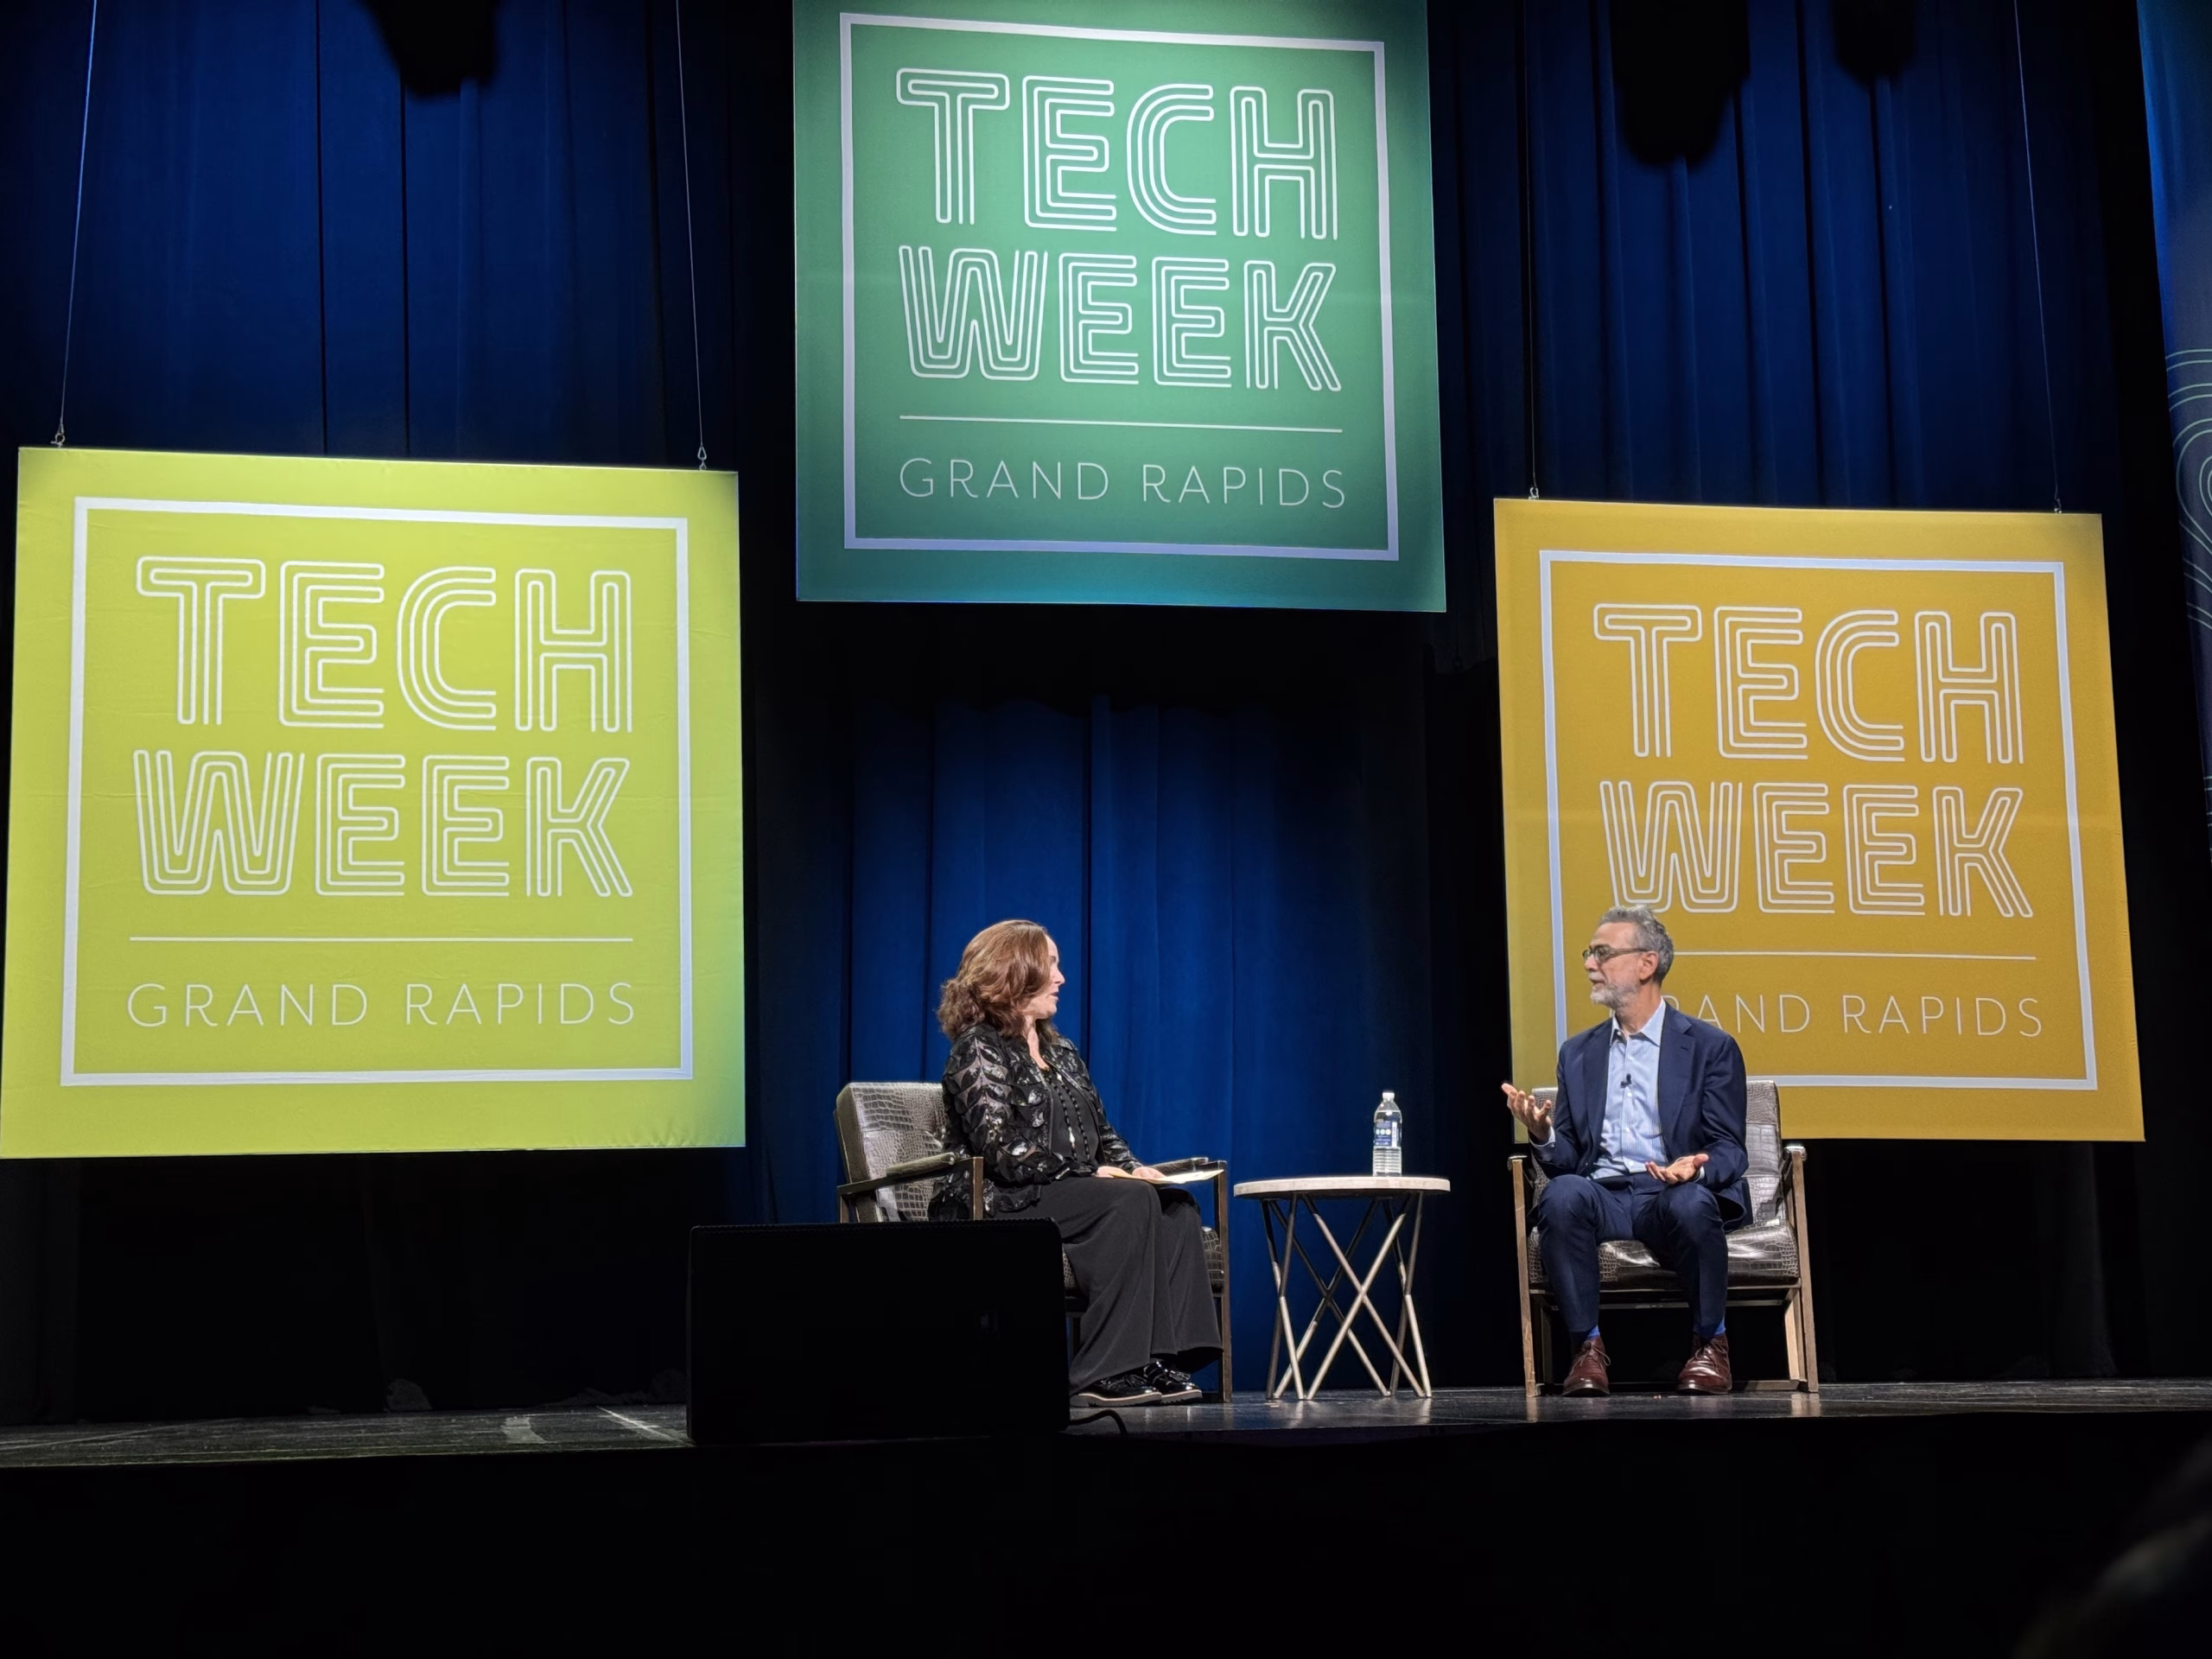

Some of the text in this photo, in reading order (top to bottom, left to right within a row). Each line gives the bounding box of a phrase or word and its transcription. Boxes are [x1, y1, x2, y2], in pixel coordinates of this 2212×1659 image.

[899, 69, 1338, 239] TECH
[899, 246, 1341, 391] WEEK
[900, 459, 1344, 507] GRAND RAPIDS
[137, 556, 632, 733] TECH
[1594, 604, 2023, 764] TECH
[134, 751, 632, 897] WEEK
[1600, 781, 2031, 918] WEEK
[129, 982, 634, 1027] GRAND RAPIDS
[1609, 995, 2041, 1037] AND RAPIDS
